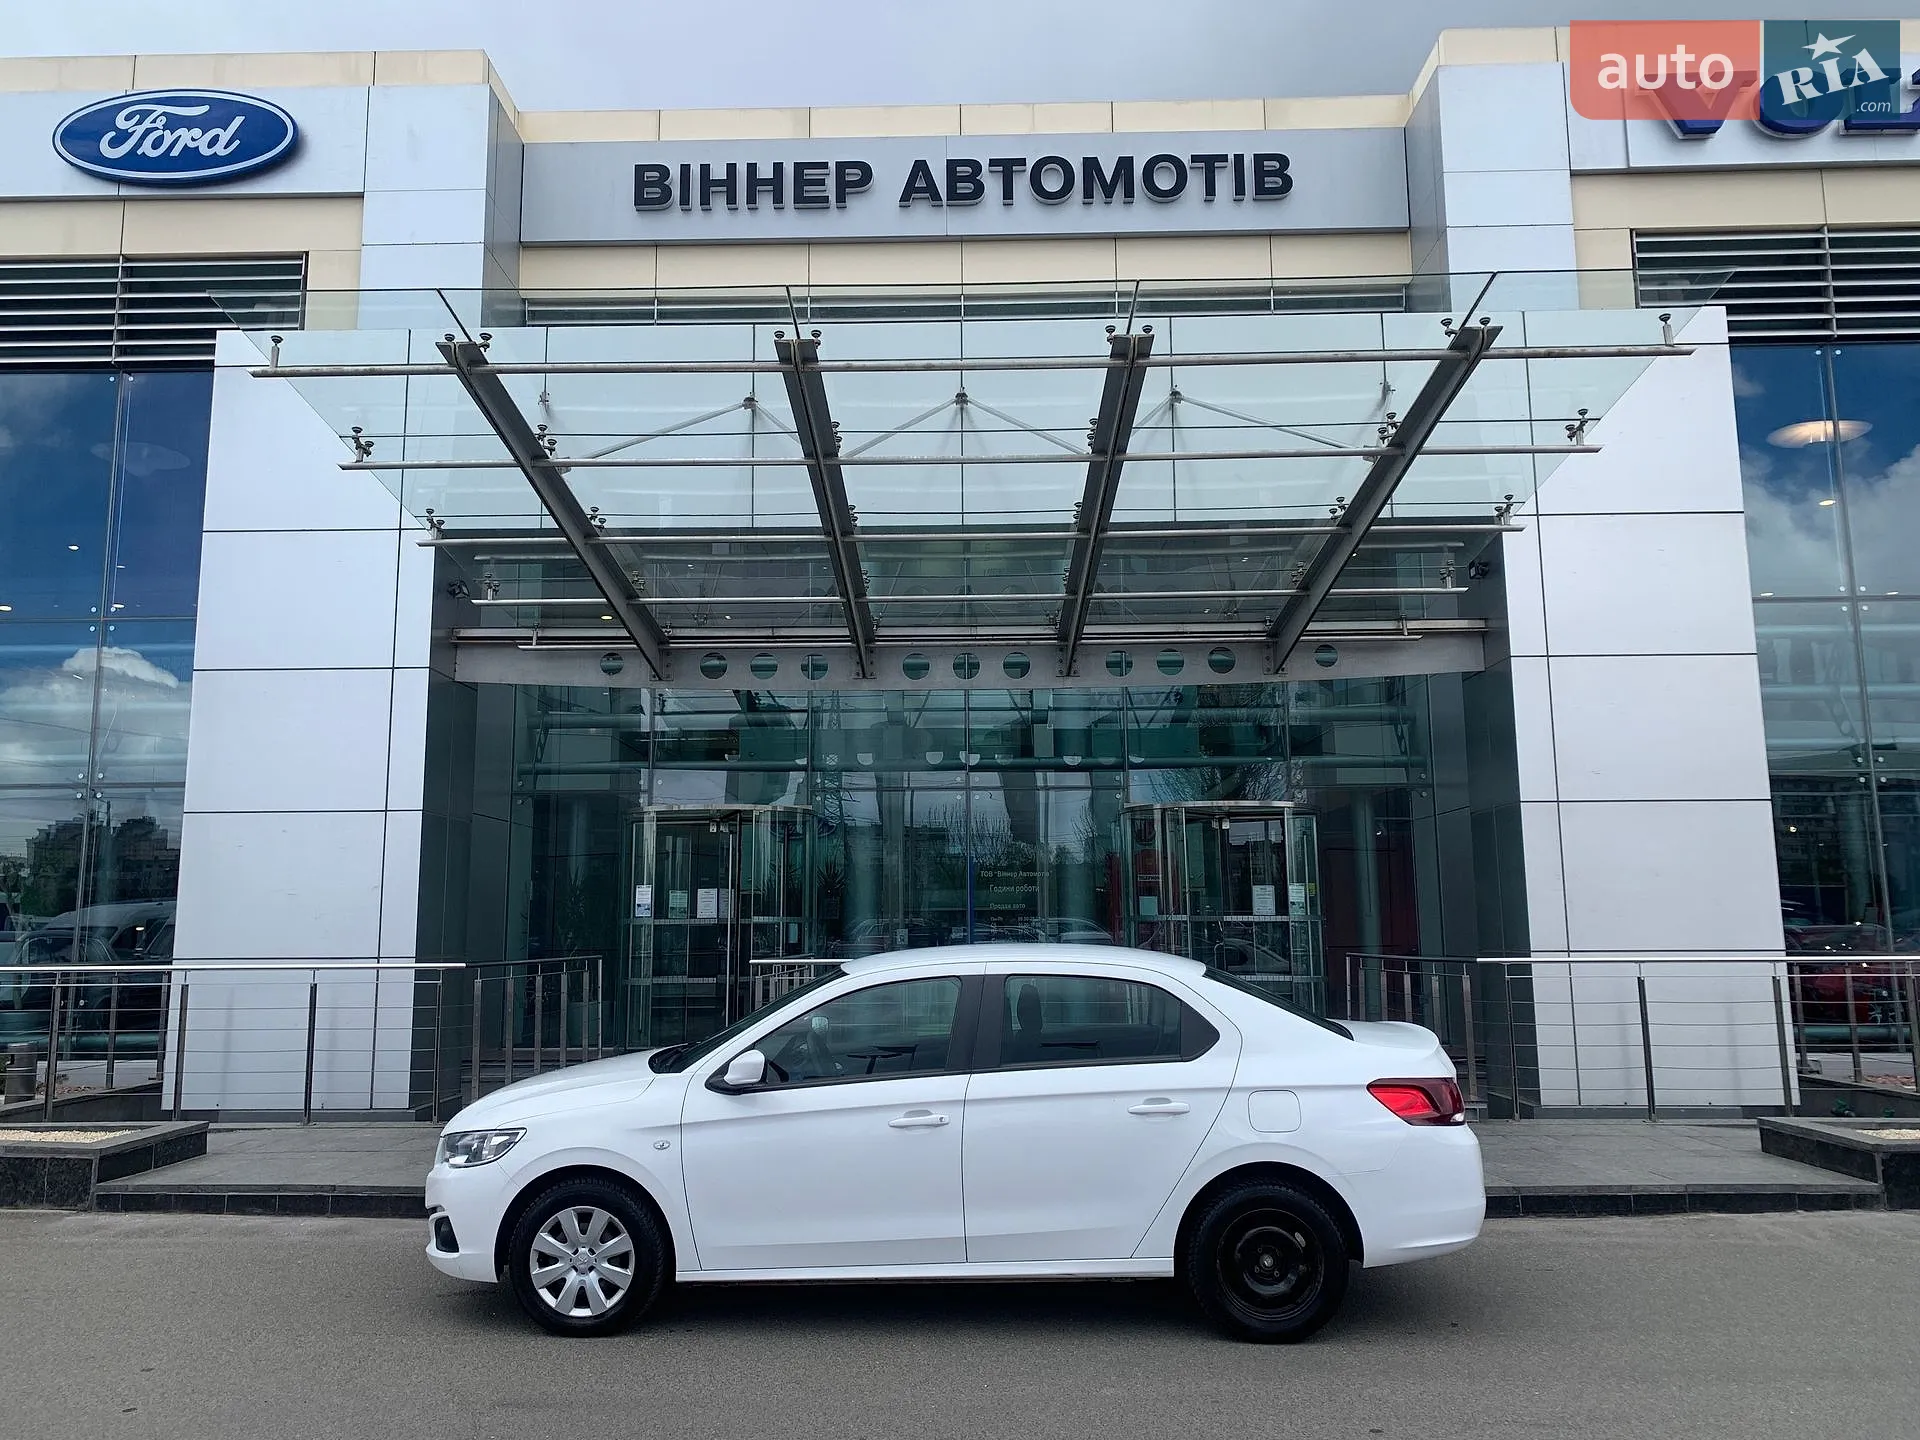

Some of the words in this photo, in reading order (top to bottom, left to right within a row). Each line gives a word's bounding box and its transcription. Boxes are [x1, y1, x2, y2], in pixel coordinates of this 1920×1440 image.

[100, 104, 246, 159] Ford
[633, 160, 874, 211] ВІННЕР
[898, 153, 1295, 207] АВТОМОТІВ
